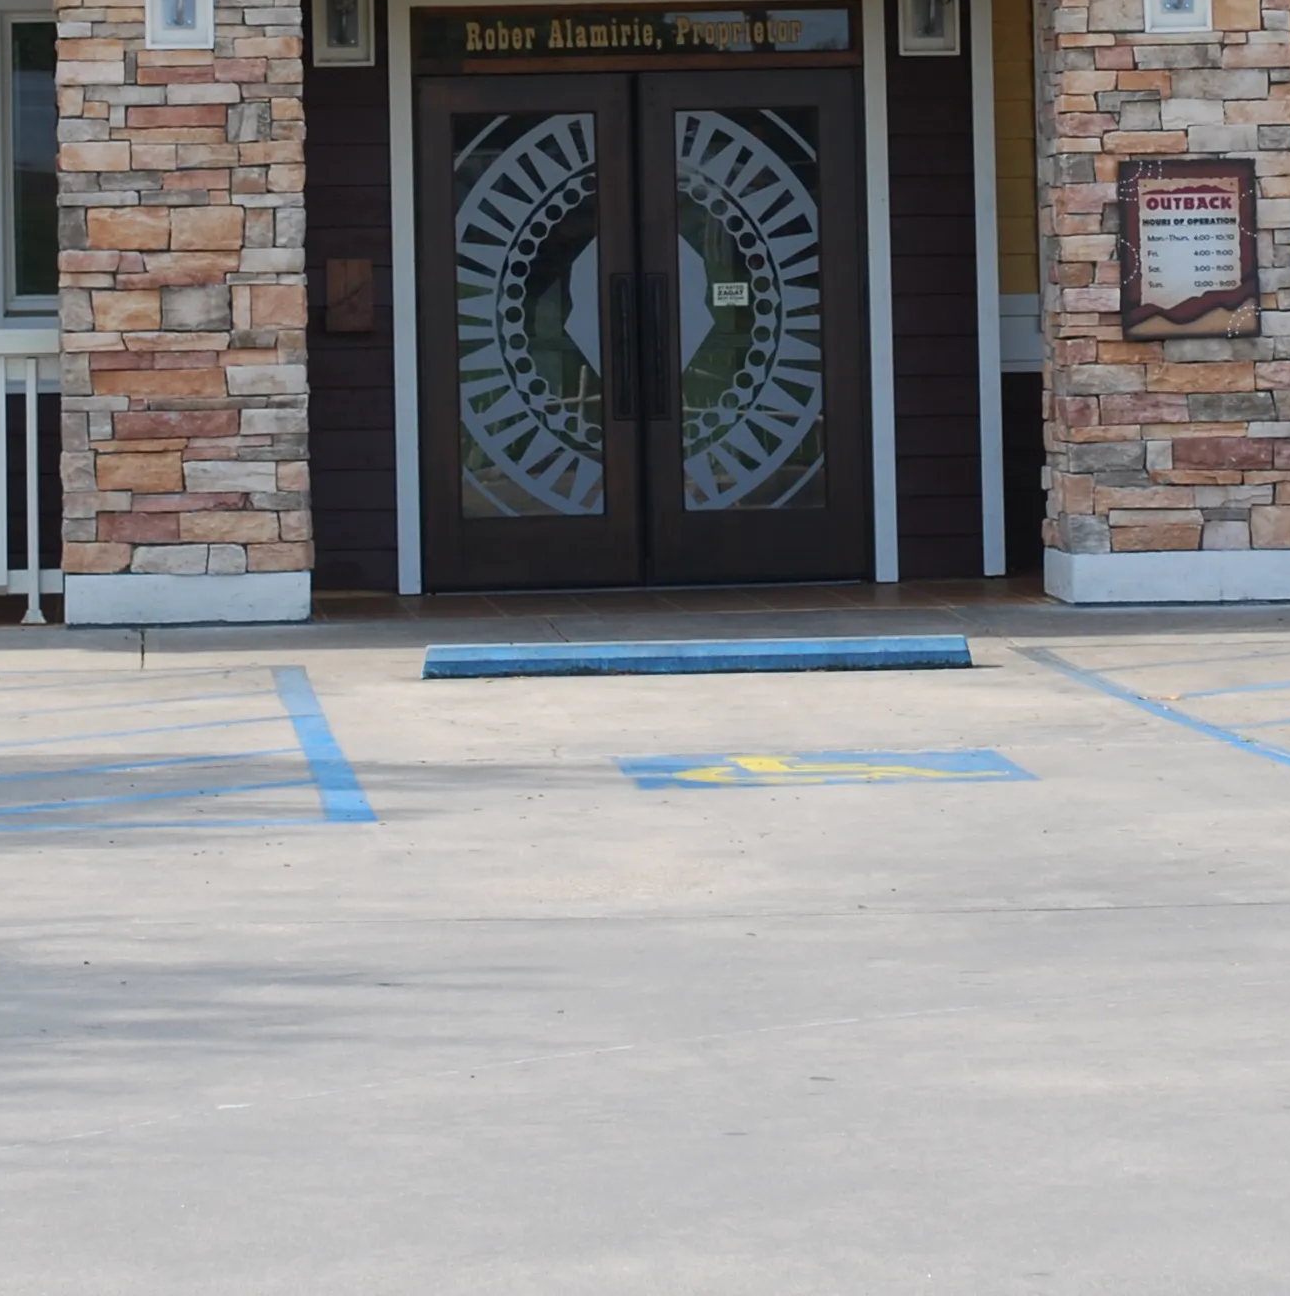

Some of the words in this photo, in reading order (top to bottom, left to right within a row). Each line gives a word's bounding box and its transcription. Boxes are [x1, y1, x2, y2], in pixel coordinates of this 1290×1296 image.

[466, 21, 536, 51] Rober
[676, 15, 803, 51] Proprietor
[1146, 197, 1232, 210] OUTBACK
[1142, 218, 1171, 226] HOURS
[1187, 217, 1237, 225] OPERATION
